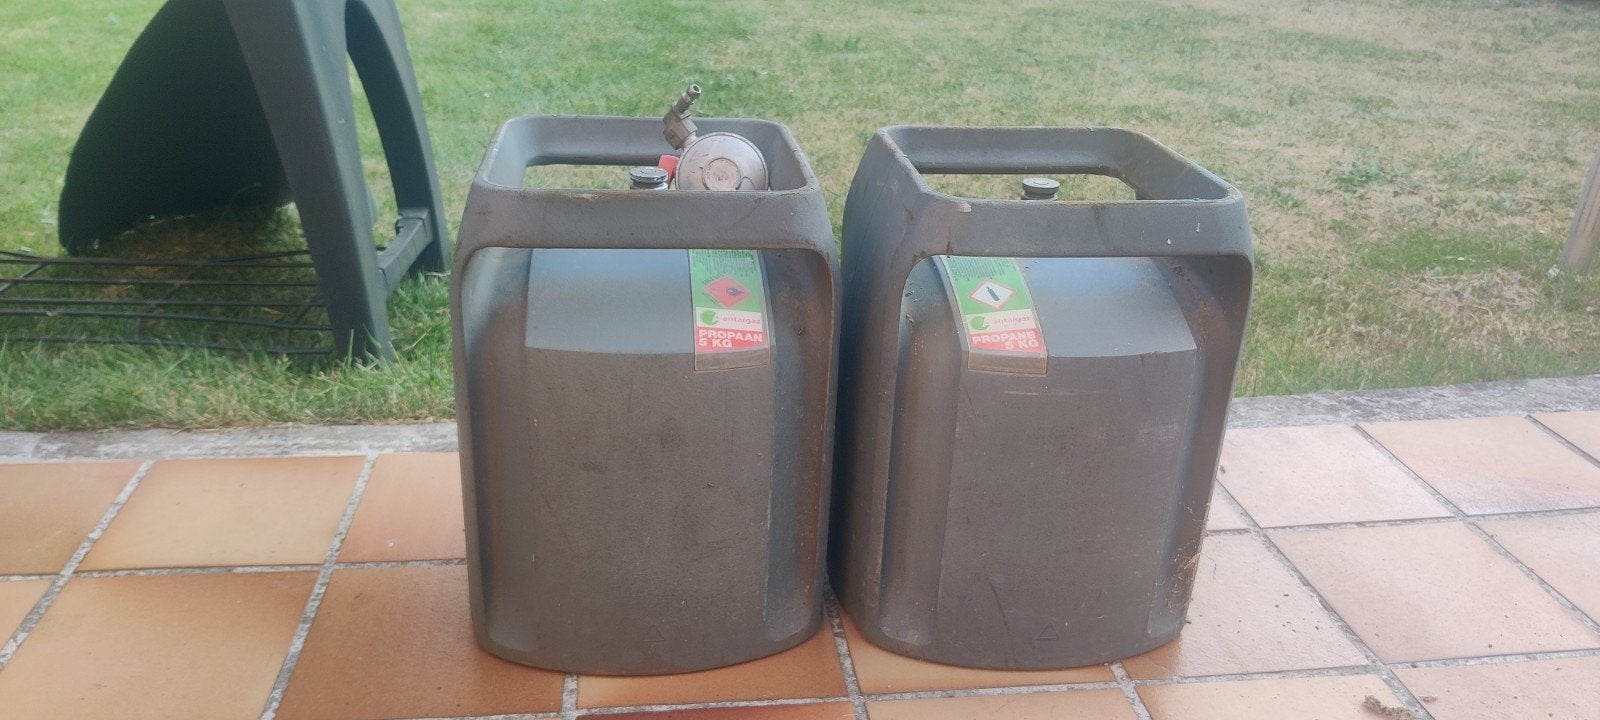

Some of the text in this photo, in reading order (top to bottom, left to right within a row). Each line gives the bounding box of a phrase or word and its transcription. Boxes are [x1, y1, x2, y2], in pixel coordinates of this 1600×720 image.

[698, 329, 763, 342] PROPAAN
[972, 330, 1036, 344] PROPANE
[698, 338, 733, 348] 5 KG
[1005, 338, 1039, 350] 5 KG
